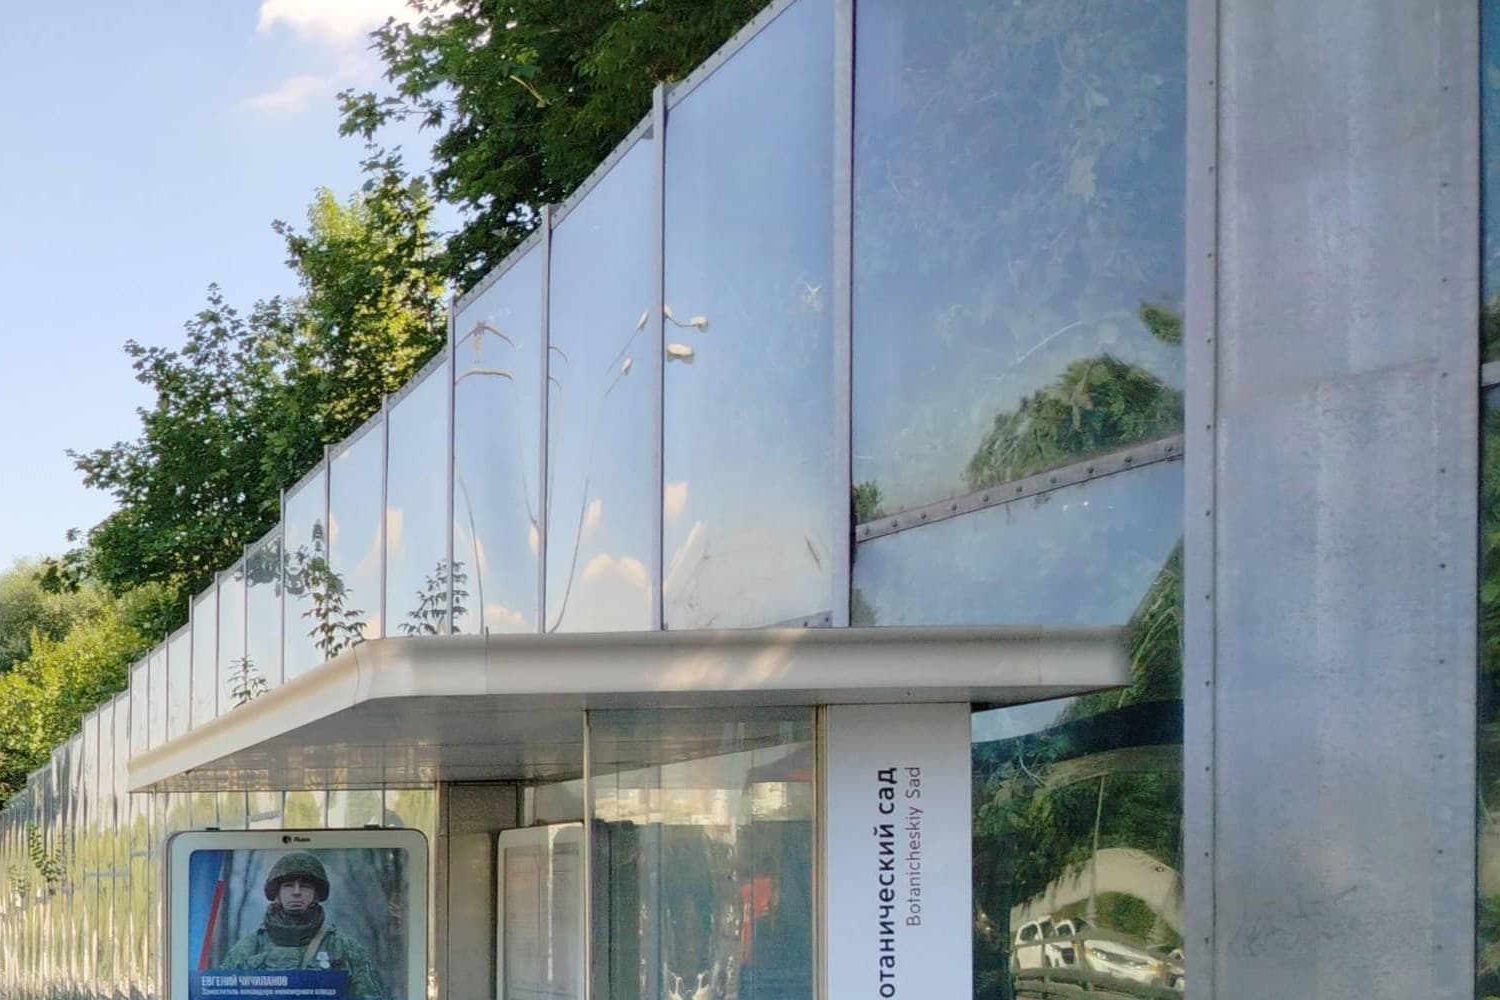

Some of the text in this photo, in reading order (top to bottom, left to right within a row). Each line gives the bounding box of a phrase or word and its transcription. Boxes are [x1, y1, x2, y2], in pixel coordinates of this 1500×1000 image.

[877, 767, 897, 814] сад
[905, 767, 924, 926] Botanicheskiy Sad
[201, 975, 238, 986] ЕВГЕНИЙ
